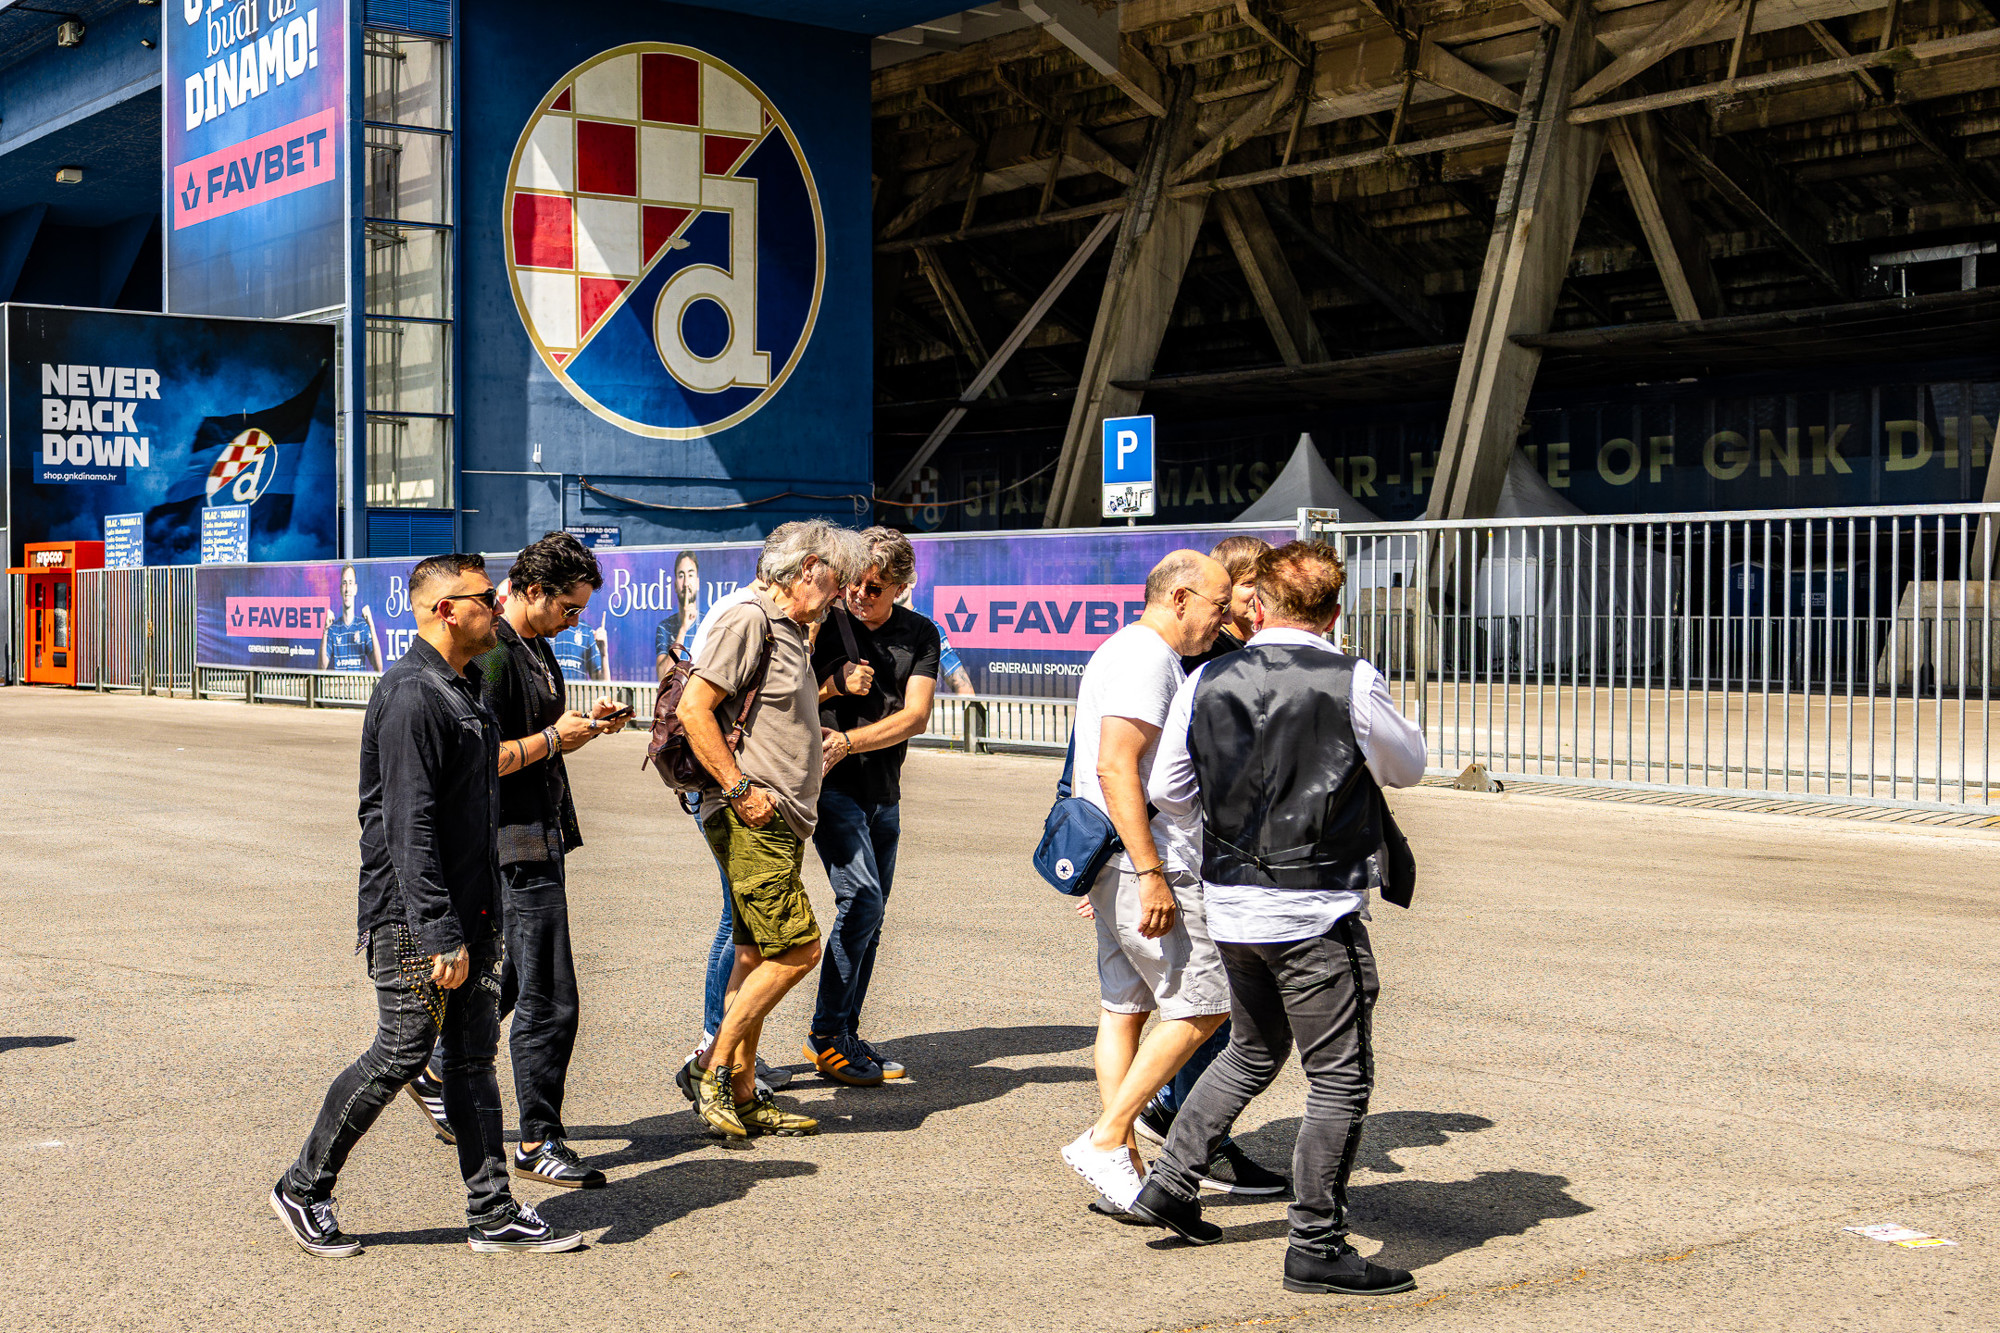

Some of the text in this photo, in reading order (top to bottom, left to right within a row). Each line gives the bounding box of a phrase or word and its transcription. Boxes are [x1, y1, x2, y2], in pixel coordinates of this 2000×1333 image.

[185, 8, 318, 132] DINAMO!
[207, 128, 327, 204] FAVBET
[42, 363, 161, 400] NEVER
[42, 398, 139, 433] BACK
[42, 433, 149, 468] DOWN
[1117, 429, 1138, 470] P
[1597, 435, 1675, 486] OF
[1703, 423, 1853, 481] GNK
[1885, 414, 1996, 472] DIN
[43, 471, 117, 482] shop.gnkdinamo.hr
[386, 576, 413, 618] Bu
[608, 568, 673, 617] Budi
[248, 606, 325, 629] FAVBET
[988, 600, 1147, 635] FAVBE
[988, 661, 1088, 677] GENERALNI SPONZO
